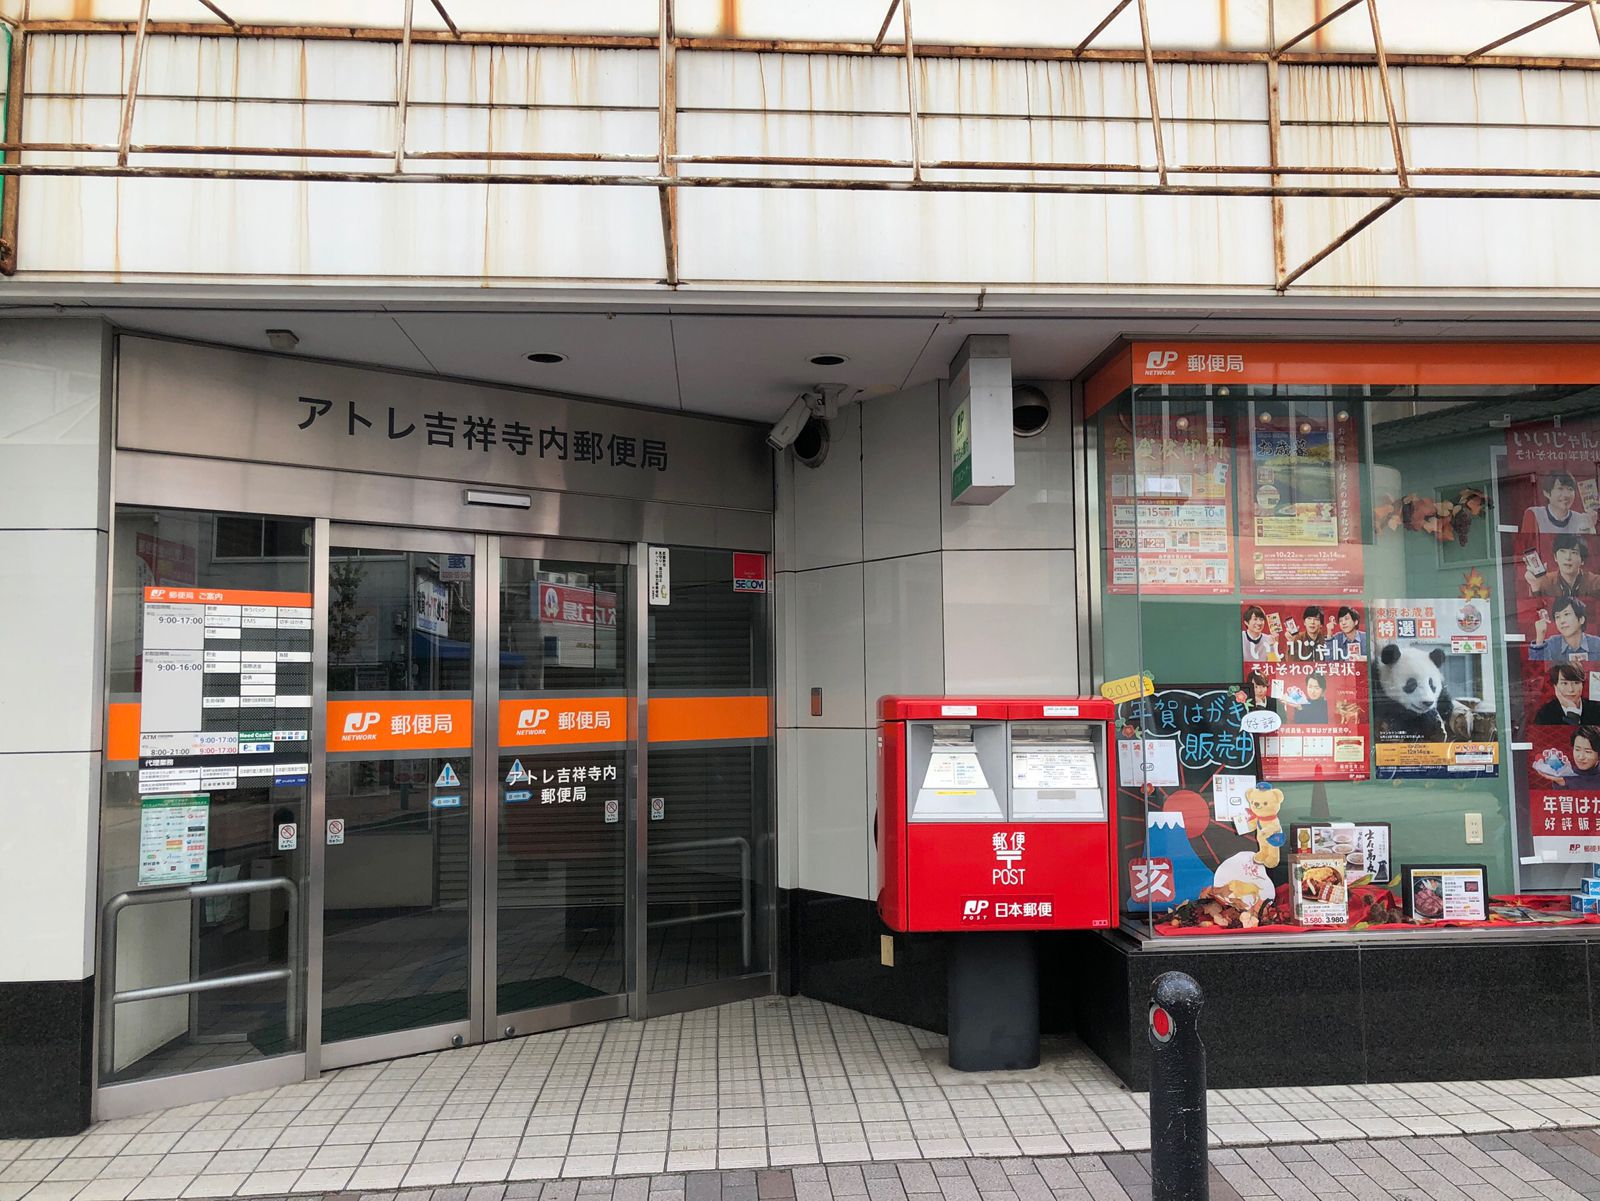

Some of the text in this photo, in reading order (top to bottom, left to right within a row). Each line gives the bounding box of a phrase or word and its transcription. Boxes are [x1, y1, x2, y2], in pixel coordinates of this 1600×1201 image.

[1146, 351, 1178, 369] JP
[1187, 354, 1244, 373] 郵便局
[298, 396, 668, 472] アトレ吉祥寺内郵便局
[1257, 439, 1309, 456] お歳暮
[735, 579, 764, 589] SECOM
[158, 616, 203, 625] 9:00-17:00
[1376, 607, 1434, 618] 東京お歳暮
[1378, 620, 1435, 637] 特選品
[157, 663, 202, 671] 9:00-16:00
[1251, 663, 1361, 677] それぞれの年賀状。
[518, 709, 549, 728] JP
[558, 711, 611, 731] 郵便局
[1129, 695, 1246, 729] 年賀はがき
[344, 713, 380, 732] JP
[391, 714, 452, 735] 郵便局
[1246, 716, 1277, 731] 好評
[1184, 730, 1254, 763] 販売中
[509, 765, 616, 786] アトレ吉祥寺内
[541, 786, 586, 804] 郵便局
[992, 832, 1026, 850] 郵便
[992, 869, 1026, 885] POST
[1131, 861, 1171, 898] 亥
[964, 900, 989, 915] JP
[995, 903, 1052, 917] 日本郵便
